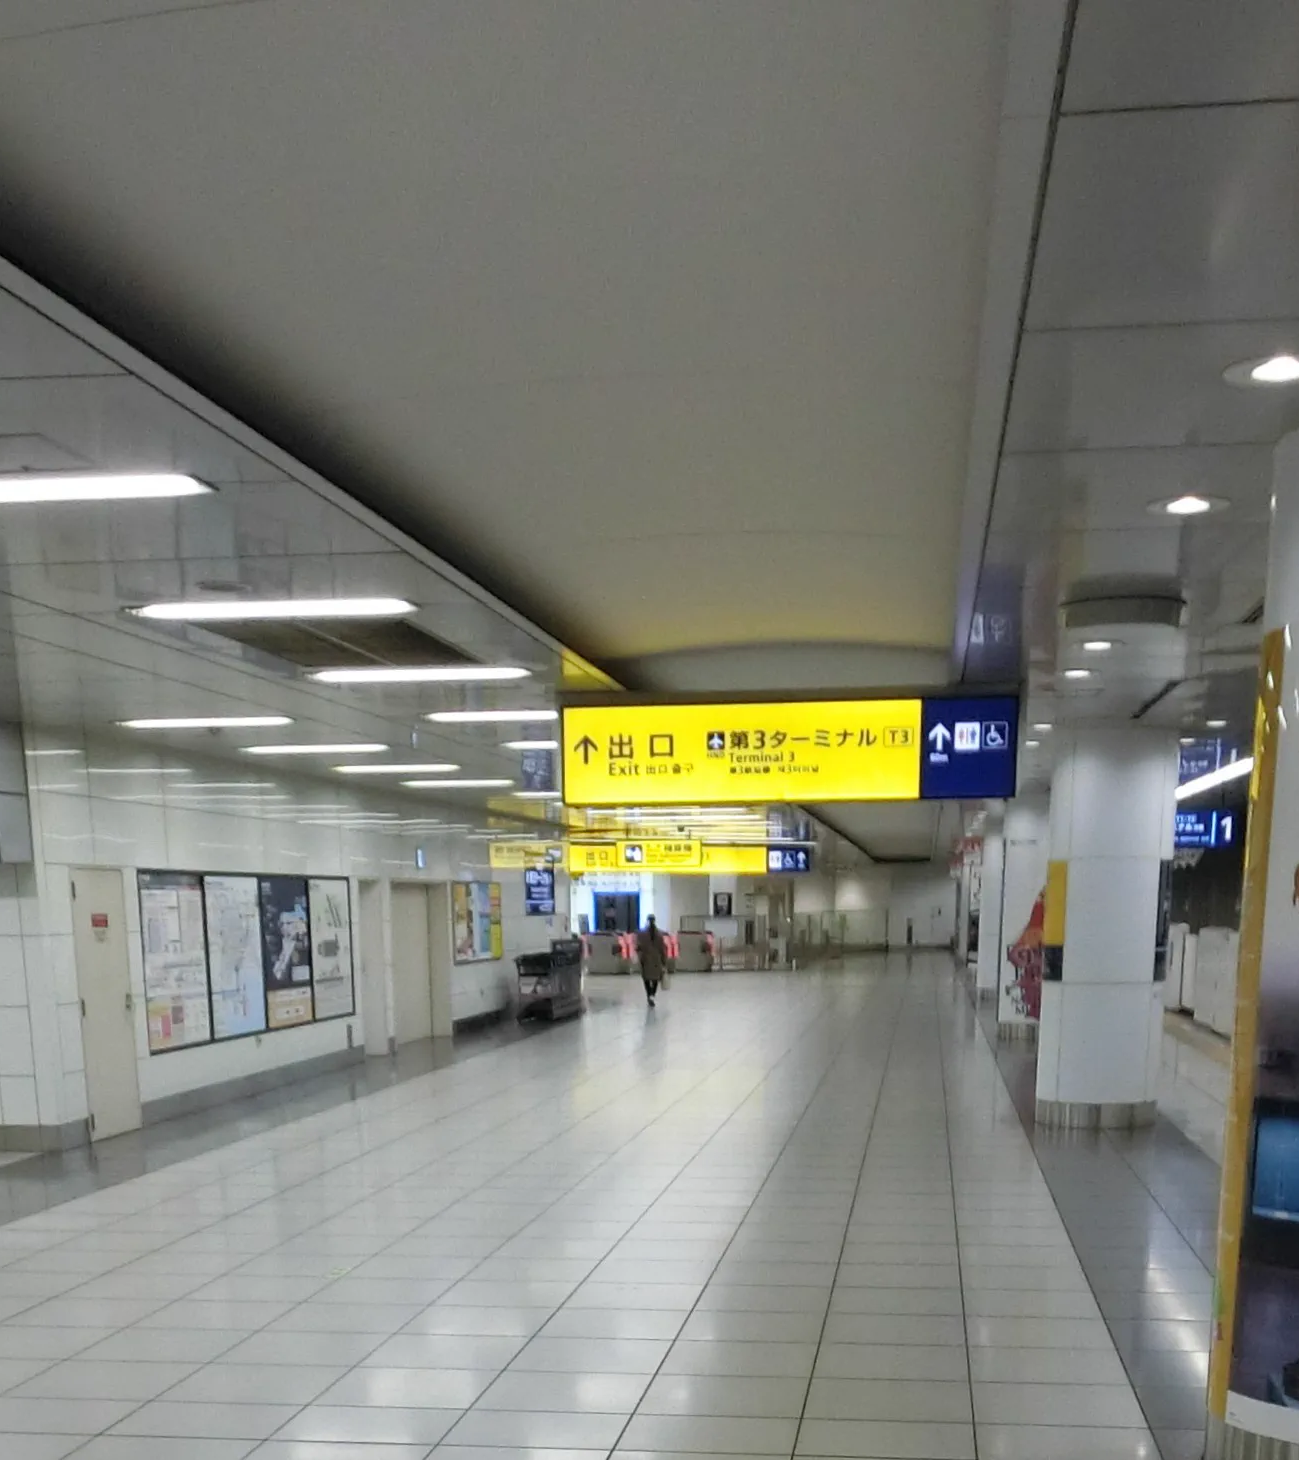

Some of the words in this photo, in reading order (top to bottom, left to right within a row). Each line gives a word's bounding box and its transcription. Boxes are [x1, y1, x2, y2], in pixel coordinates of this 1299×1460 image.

[608, 733, 674, 759] 出口
[729, 729, 878, 750] 第3ターミナル
[889, 729, 909, 744] T3
[730, 752, 784, 763] Terminal
[788, 752, 796, 763] 3
[608, 761, 640, 776] Exit
[1221, 816, 1233, 842] 1
